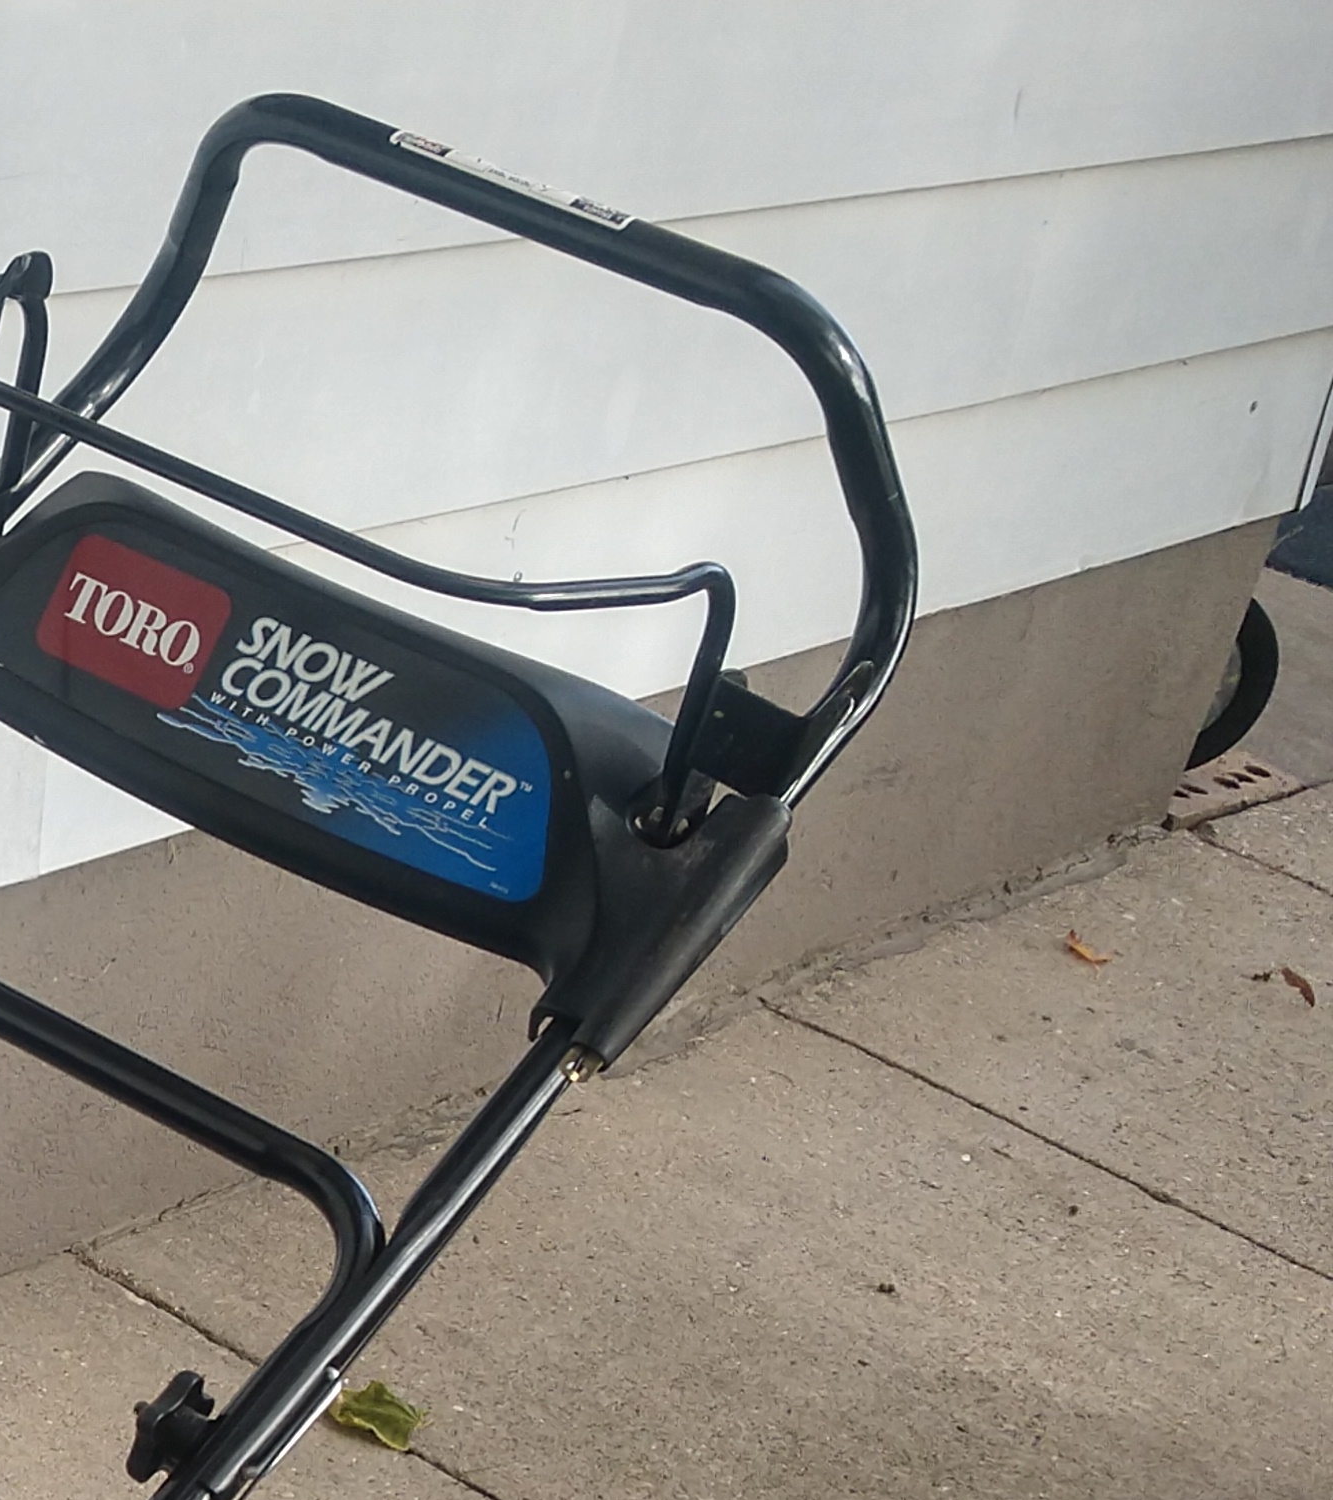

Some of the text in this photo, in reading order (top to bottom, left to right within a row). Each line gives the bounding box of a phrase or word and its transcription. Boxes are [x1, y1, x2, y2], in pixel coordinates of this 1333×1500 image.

[64, 572, 200, 667] TORO
[235, 616, 395, 702] SNOW
[209, 691, 490, 829] WITH POWER PROPEL
[221, 656, 518, 815] COMMANDER
